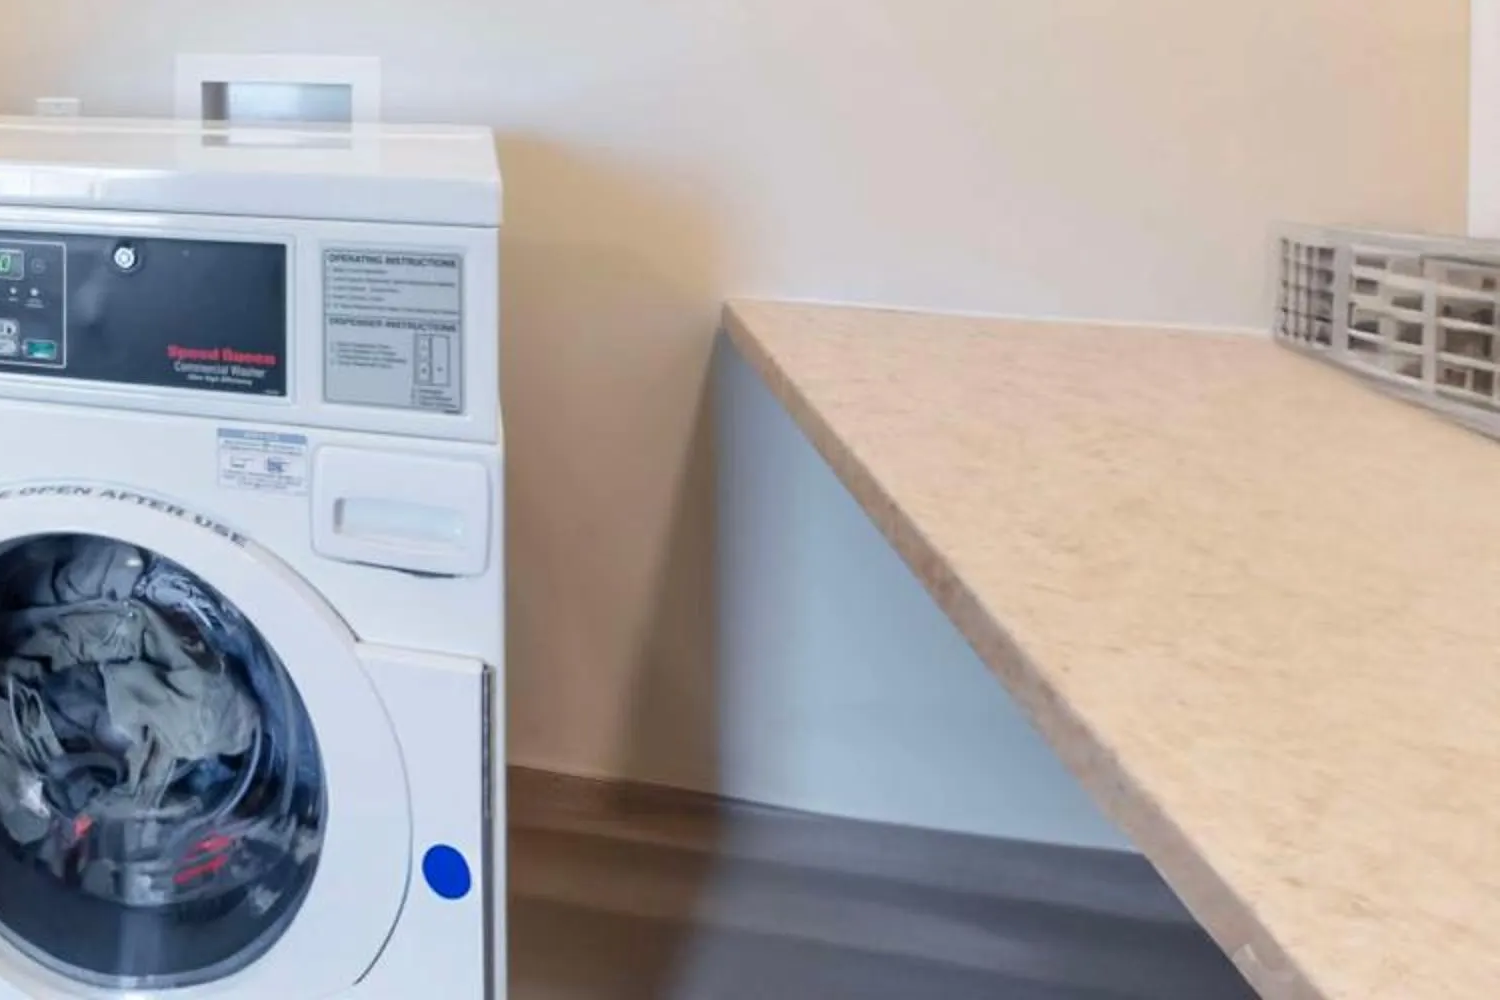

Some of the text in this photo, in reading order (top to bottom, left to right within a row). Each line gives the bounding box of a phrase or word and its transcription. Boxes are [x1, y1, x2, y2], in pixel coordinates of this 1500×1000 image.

[385, 256, 457, 269] INSTRUCTIONS
[167, 344, 219, 361] Speed
[19, 485, 92, 496] OPEN
[100, 489, 186, 517] AFTER
[194, 513, 247, 549] USE
